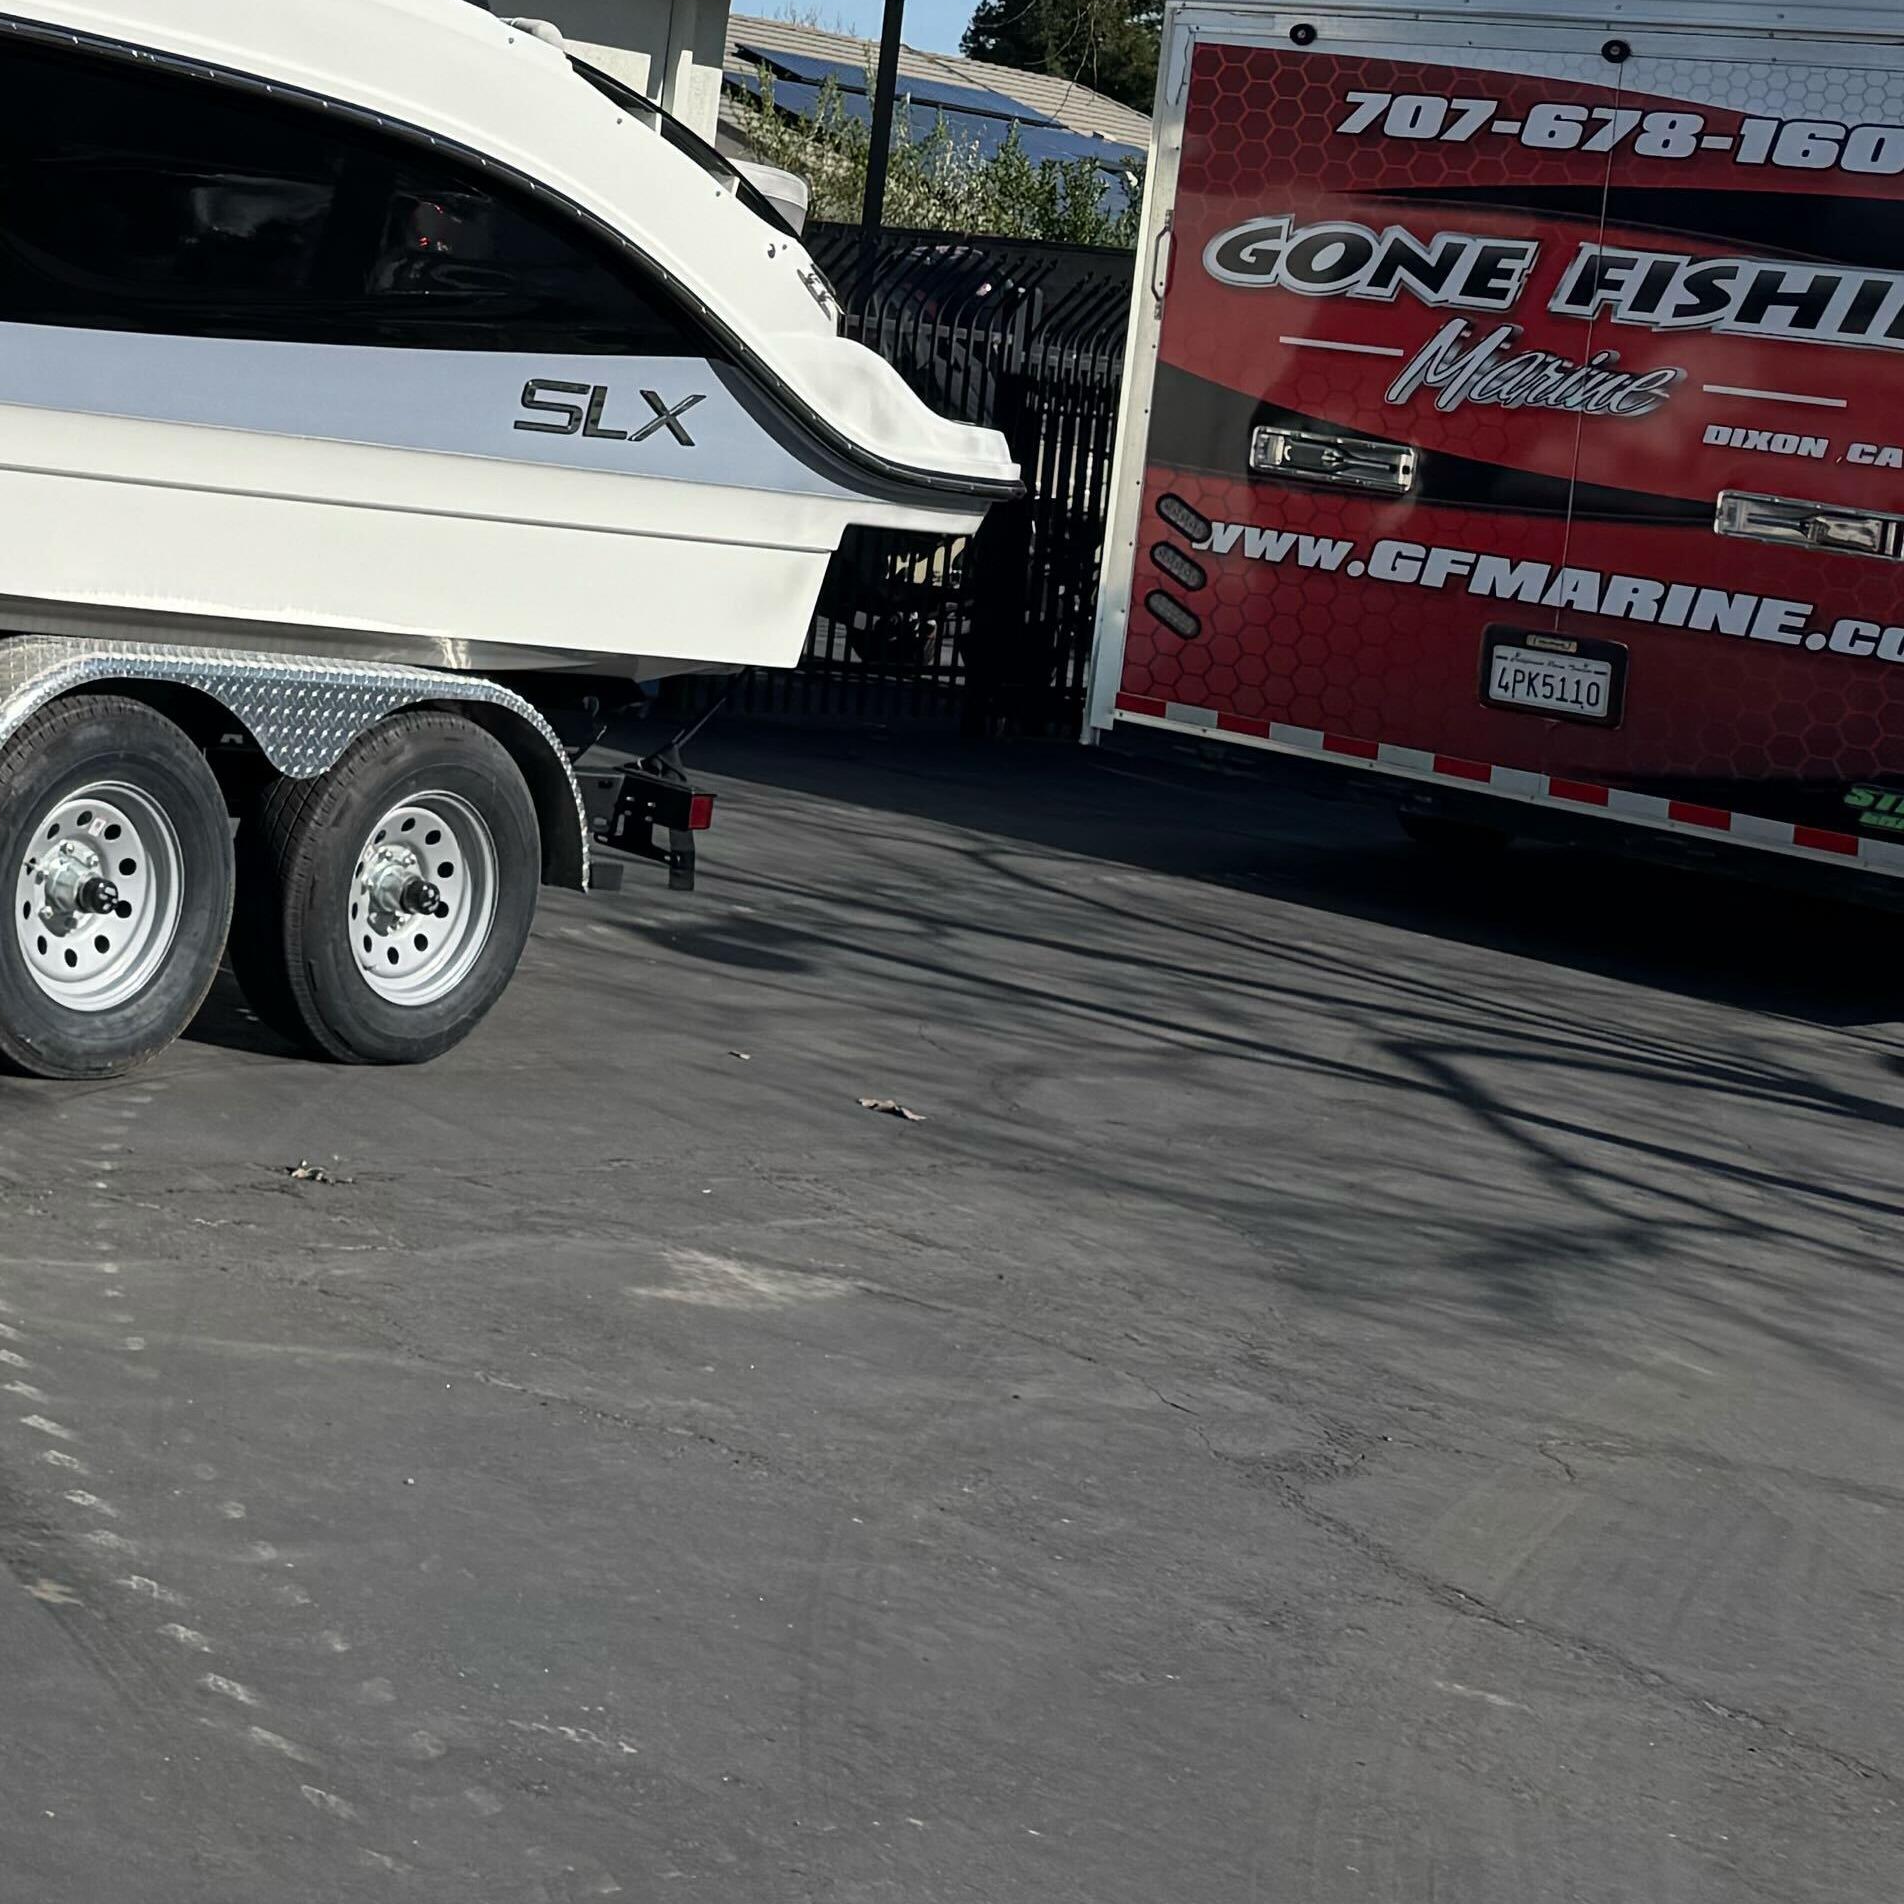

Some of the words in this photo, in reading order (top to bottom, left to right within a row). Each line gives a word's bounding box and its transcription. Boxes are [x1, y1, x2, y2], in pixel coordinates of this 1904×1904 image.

[1203, 213, 1540, 313] GONE
[1548, 241, 1904, 349] FISHI
[1385, 317, 1686, 416] Marine
[513, 377, 707, 448] SLX
[1497, 666, 1601, 708] 4PK5110
